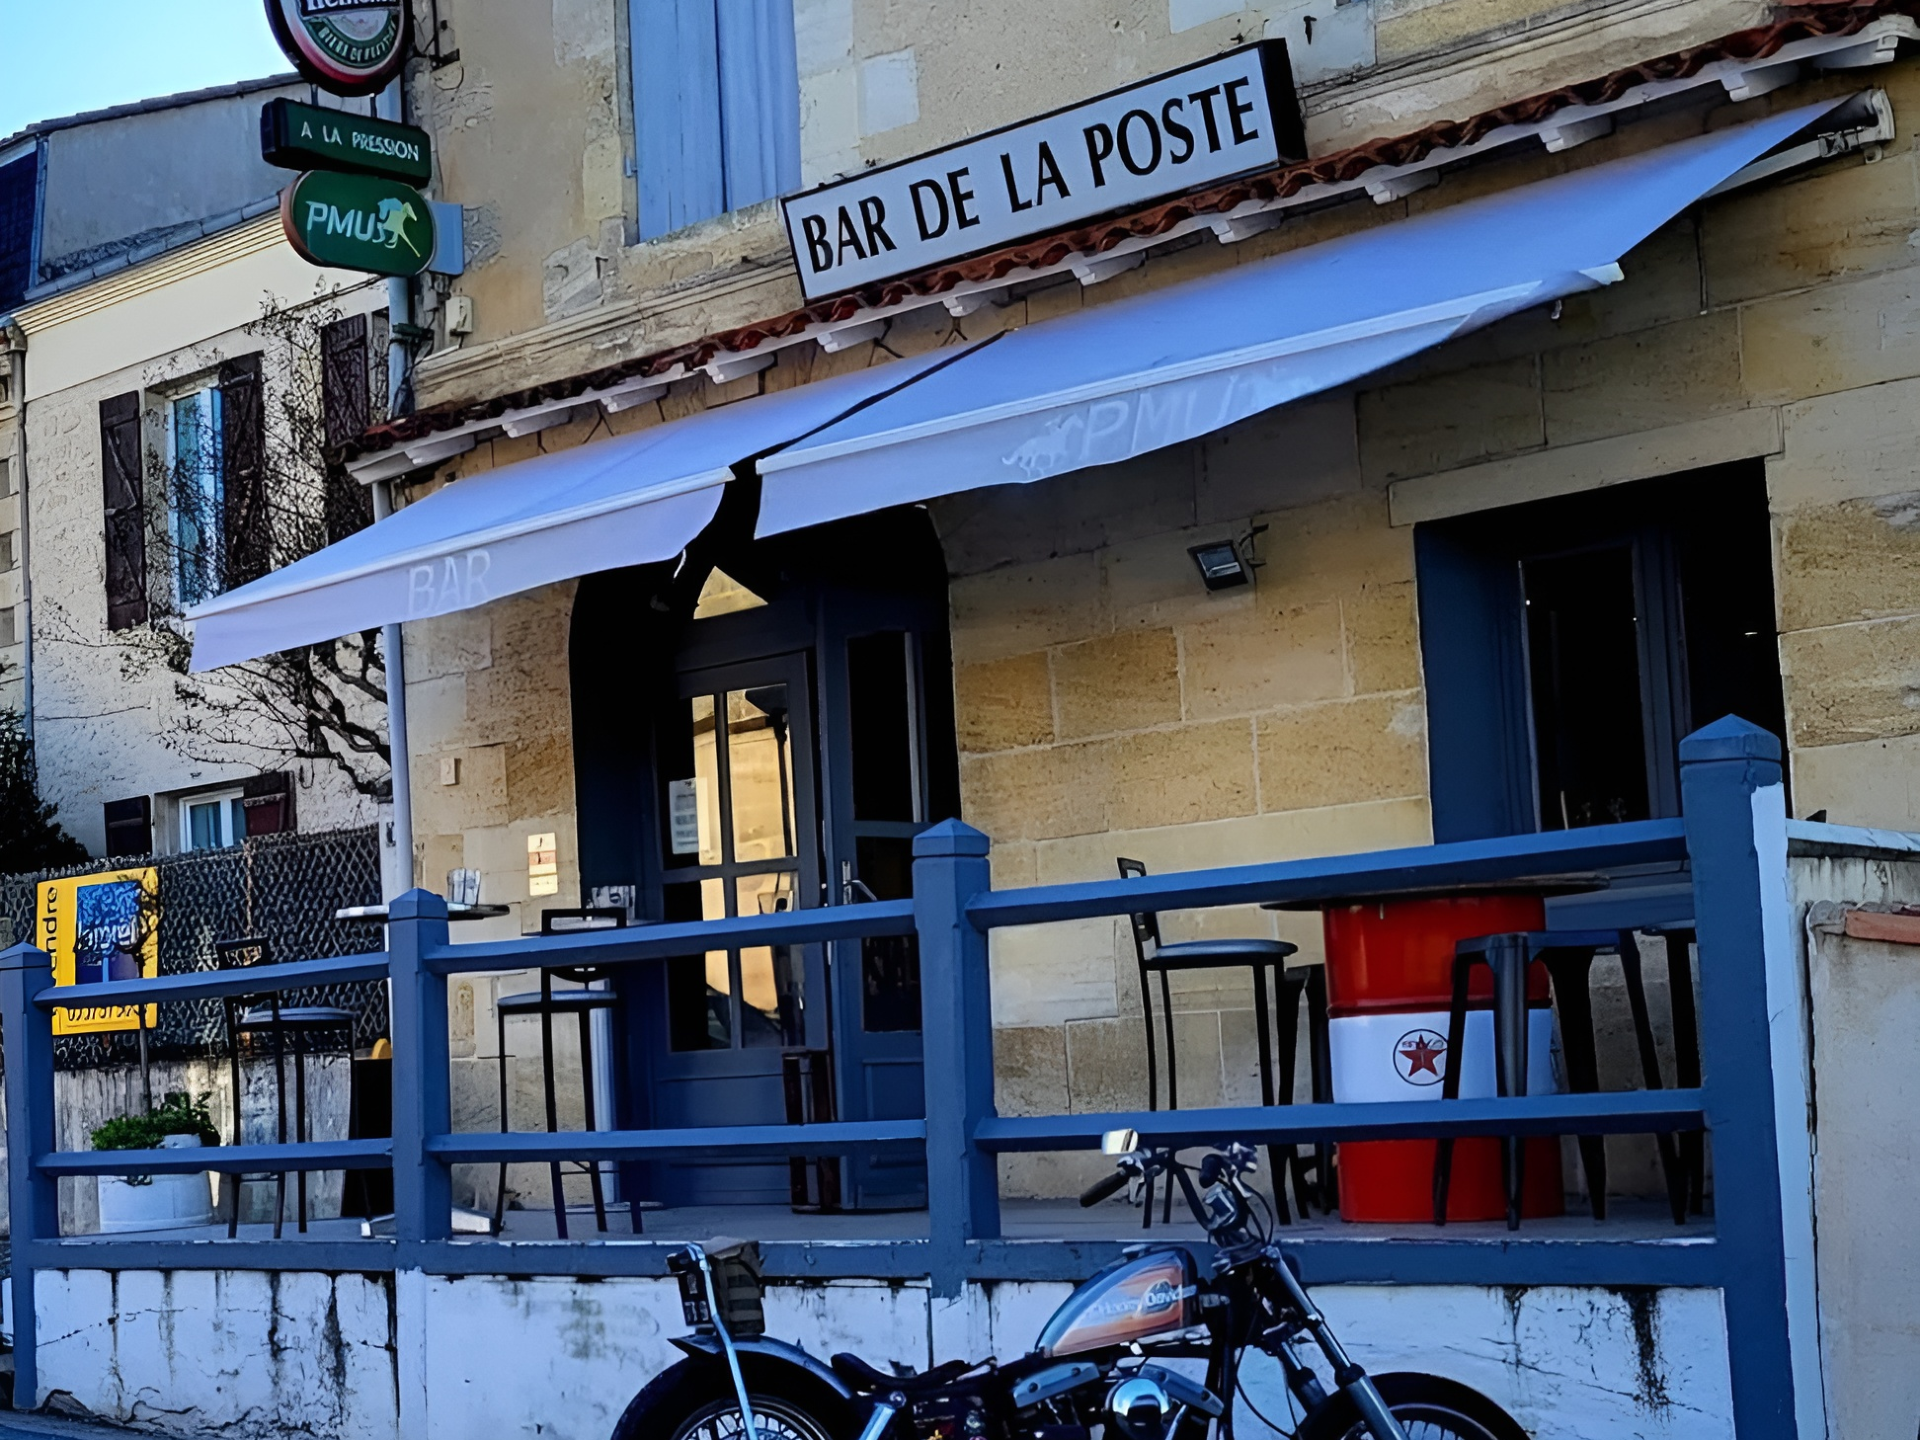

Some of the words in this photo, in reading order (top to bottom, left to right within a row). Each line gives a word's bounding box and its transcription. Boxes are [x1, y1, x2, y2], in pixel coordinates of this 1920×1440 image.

[300, 120, 313, 140] A
[322, 124, 343, 146] LA
[801, 195, 898, 275] BAR
[909, 166, 981, 242] DE
[1000, 140, 1071, 214] LA
[1082, 76, 1260, 189] POSTE
[305, 200, 374, 242] PMU
[407, 548, 492, 617] BAR
